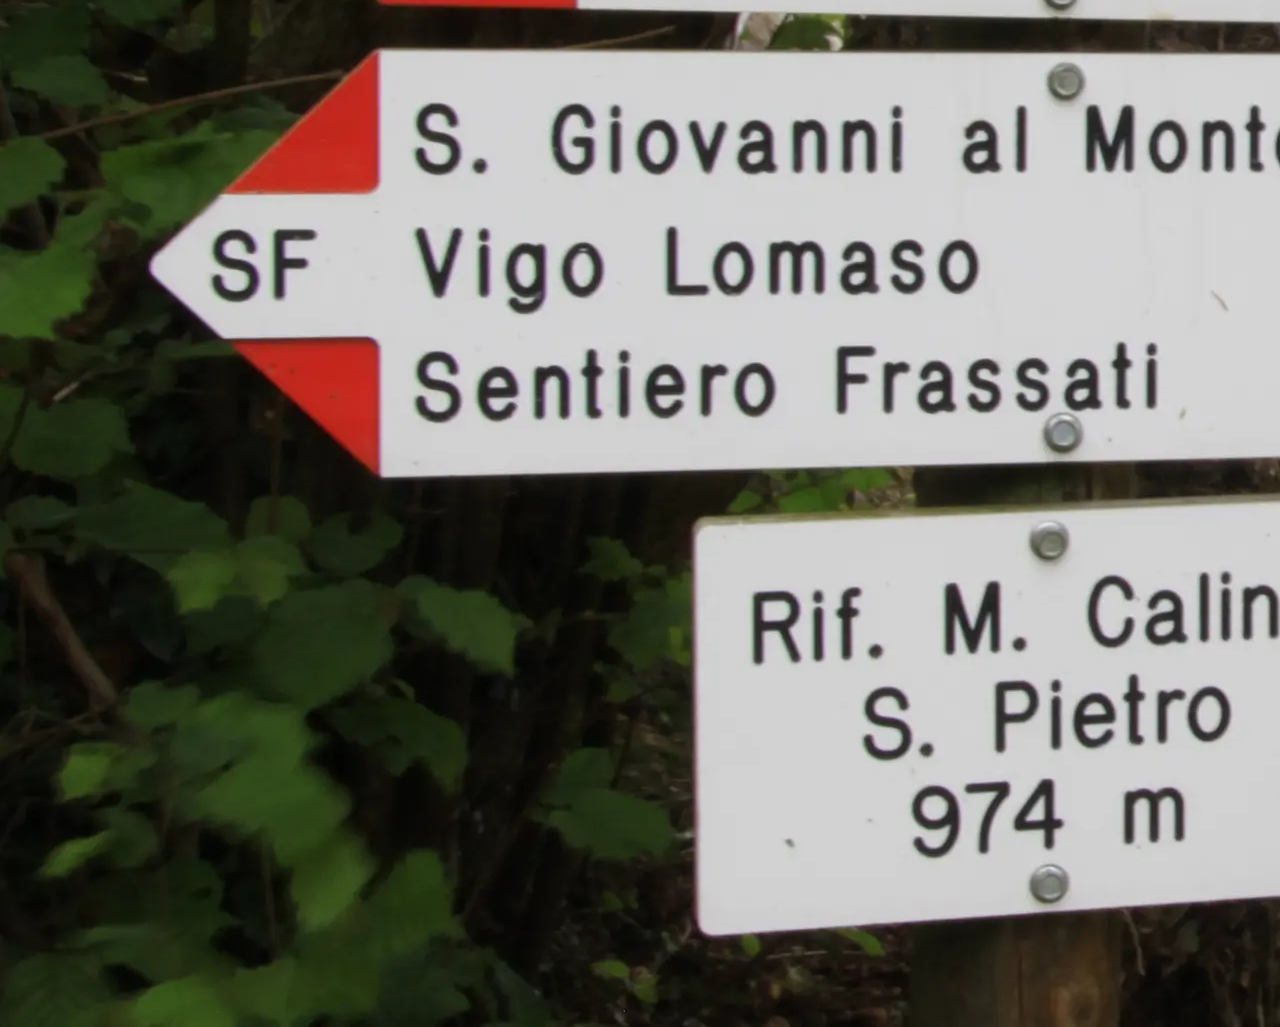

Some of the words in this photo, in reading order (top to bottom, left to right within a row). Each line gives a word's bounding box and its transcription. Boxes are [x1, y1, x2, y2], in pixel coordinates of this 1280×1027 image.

[415, 103, 488, 177] S.
[551, 103, 903, 177] Giovanni
[963, 104, 1028, 176] al
[211, 229, 318, 304] SF
[415, 227, 605, 317] Vigo
[666, 226, 980, 301] Lomaso
[415, 350, 776, 424] Sentiero
[836, 342, 1158, 417] Frassati
[752, 586, 884, 666] Rif.
[944, 581, 1028, 656] M.
[863, 686, 935, 762] S.
[995, 673, 1232, 755] Pietro
[911, 778, 1064, 861] 974
[1122, 787, 1186, 847] m
